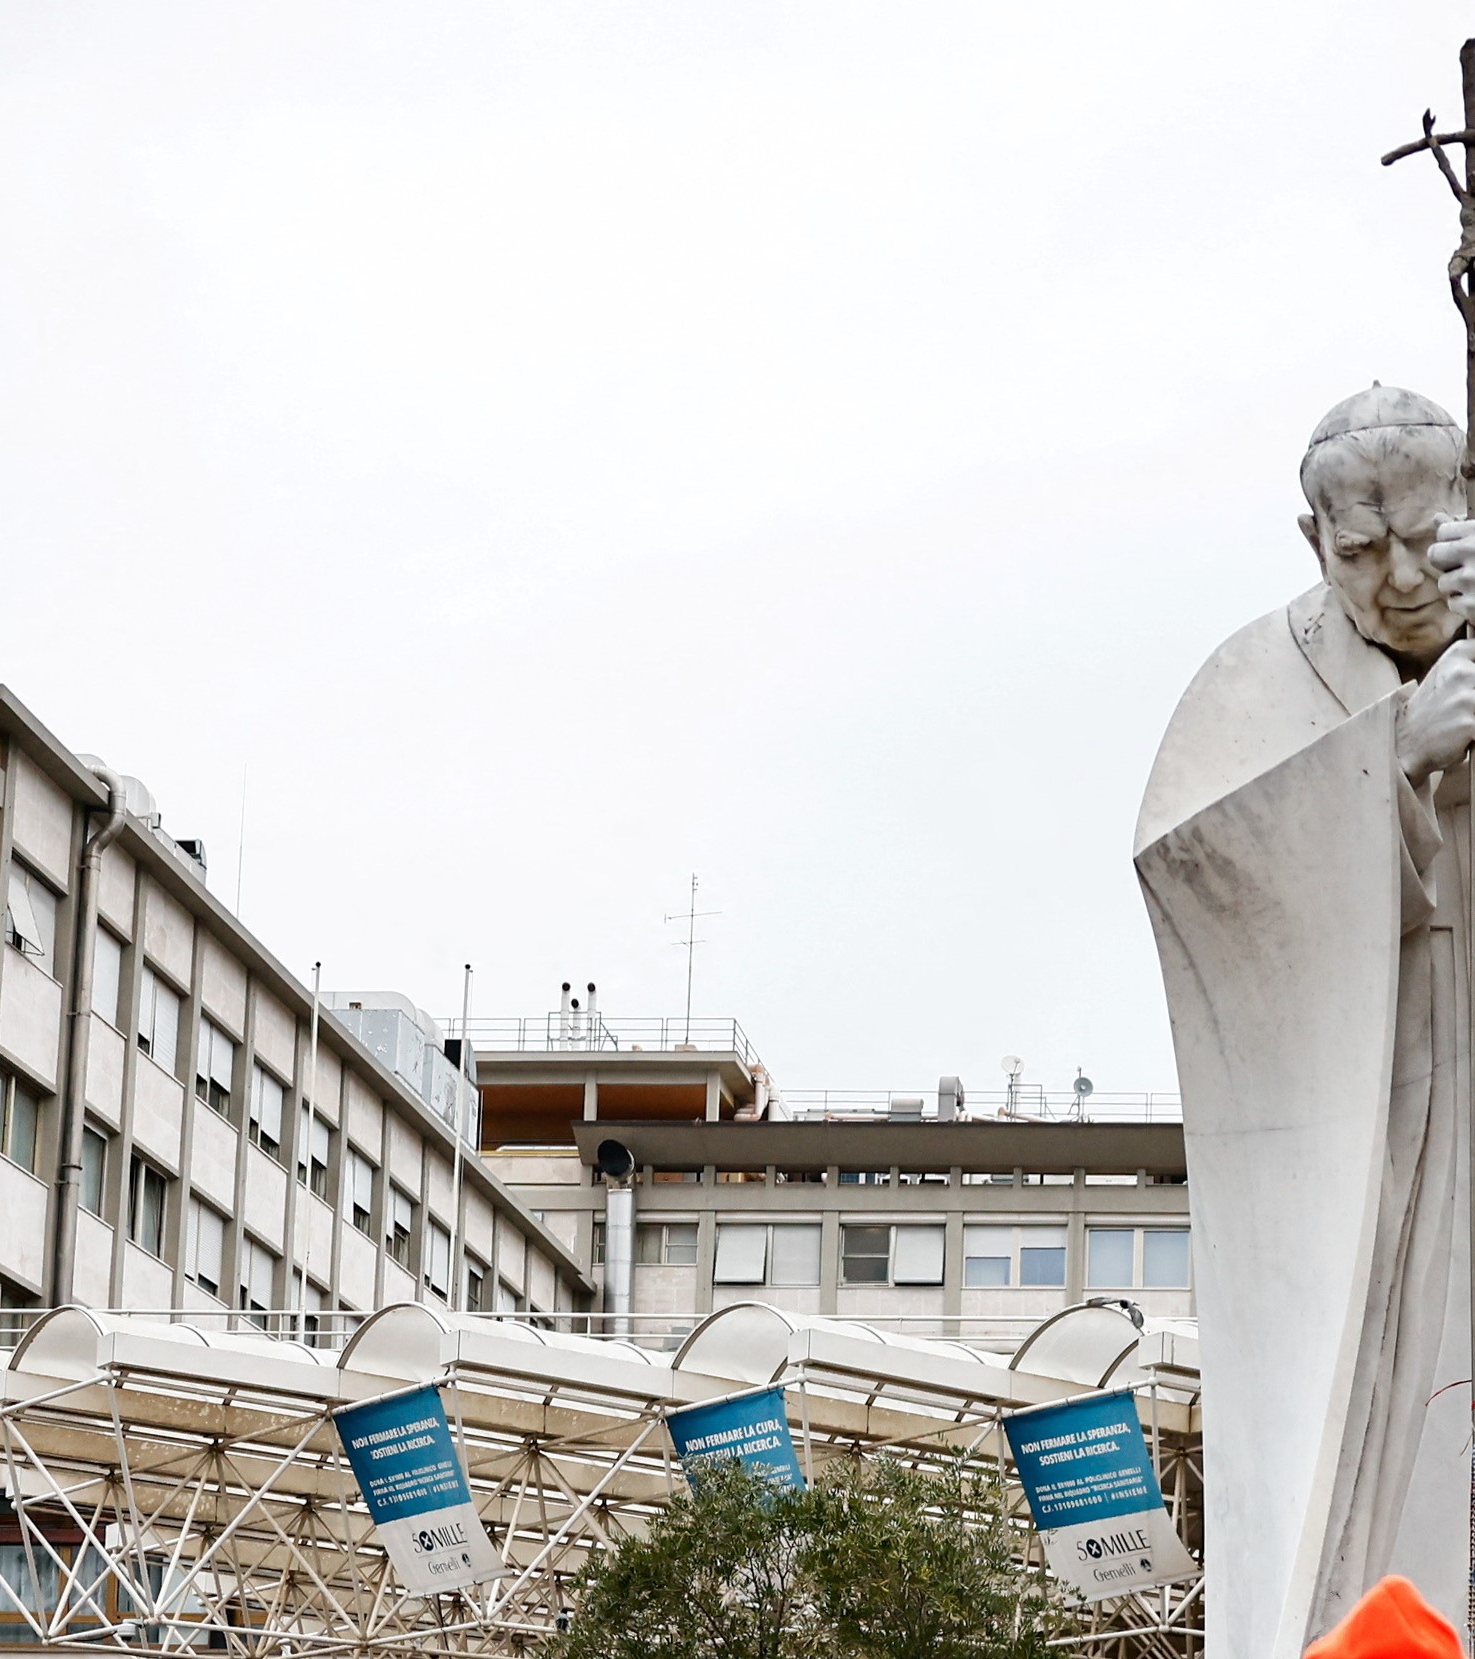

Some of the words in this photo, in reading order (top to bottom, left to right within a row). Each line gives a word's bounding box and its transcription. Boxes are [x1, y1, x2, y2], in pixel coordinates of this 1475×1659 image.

[352, 1436, 369, 1449] NON
[369, 1428, 398, 1445] FERMARE
[397, 1425, 407, 1438] LA
[407, 1417, 440, 1434] SPERANZA,
[685, 1437, 706, 1452] NON
[706, 1427, 744, 1447] FERMARE
[744, 1425, 756, 1438] LA
[756, 1419, 782, 1434] CURA,
[1021, 1442, 1040, 1454] NON
[1040, 1434, 1076, 1450] FERMARE
[1076, 1432, 1087, 1442] LA
[1087, 1423, 1131, 1440] SPERANZA,
[399, 1441, 408, 1453] LA
[1039, 1449, 1074, 1466] SOSTIENI
[1074, 1446, 1087, 1459] LA
[1086, 1441, 1120, 1456] RICERCA.
[1035, 1485, 1051, 1493] DONA
[1085, 1471, 1117, 1483] POLICLINICO
[1118, 1467, 1141, 1477] GEMELLI
[1038, 1494, 1054, 1502] FIRMA
[1064, 1486, 1090, 1497] RIQUADRO
[1042, 1505, 1054, 1513] C.F.
[1111, 1486, 1148, 1500] #INSIEME
[428, 1558, 461, 1576] Gemelli
[1093, 1562, 1136, 1583] Gemelli
